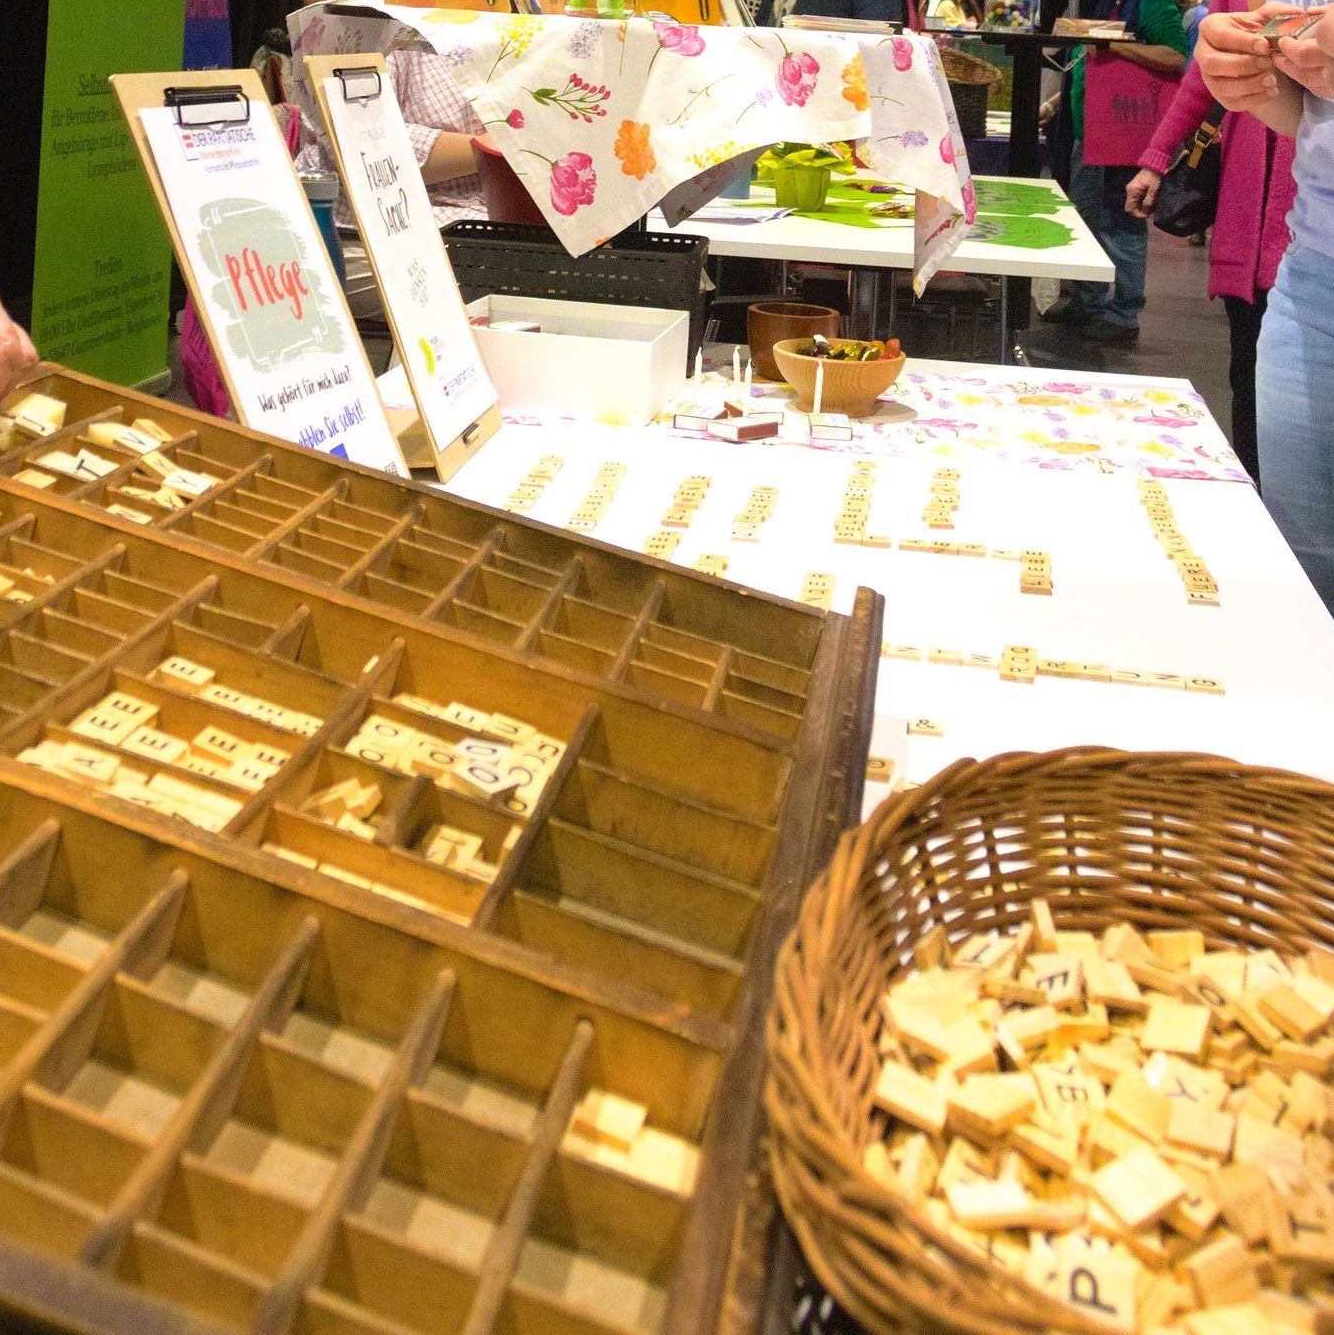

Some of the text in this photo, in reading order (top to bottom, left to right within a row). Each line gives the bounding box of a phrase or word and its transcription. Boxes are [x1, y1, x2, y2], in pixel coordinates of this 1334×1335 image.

[225, 246, 308, 321] Pflege
[257, 365, 352, 413] Was gehört für mich dazu?
[324, 416, 340, 439] Sie
[338, 398, 366, 432] selbst!
